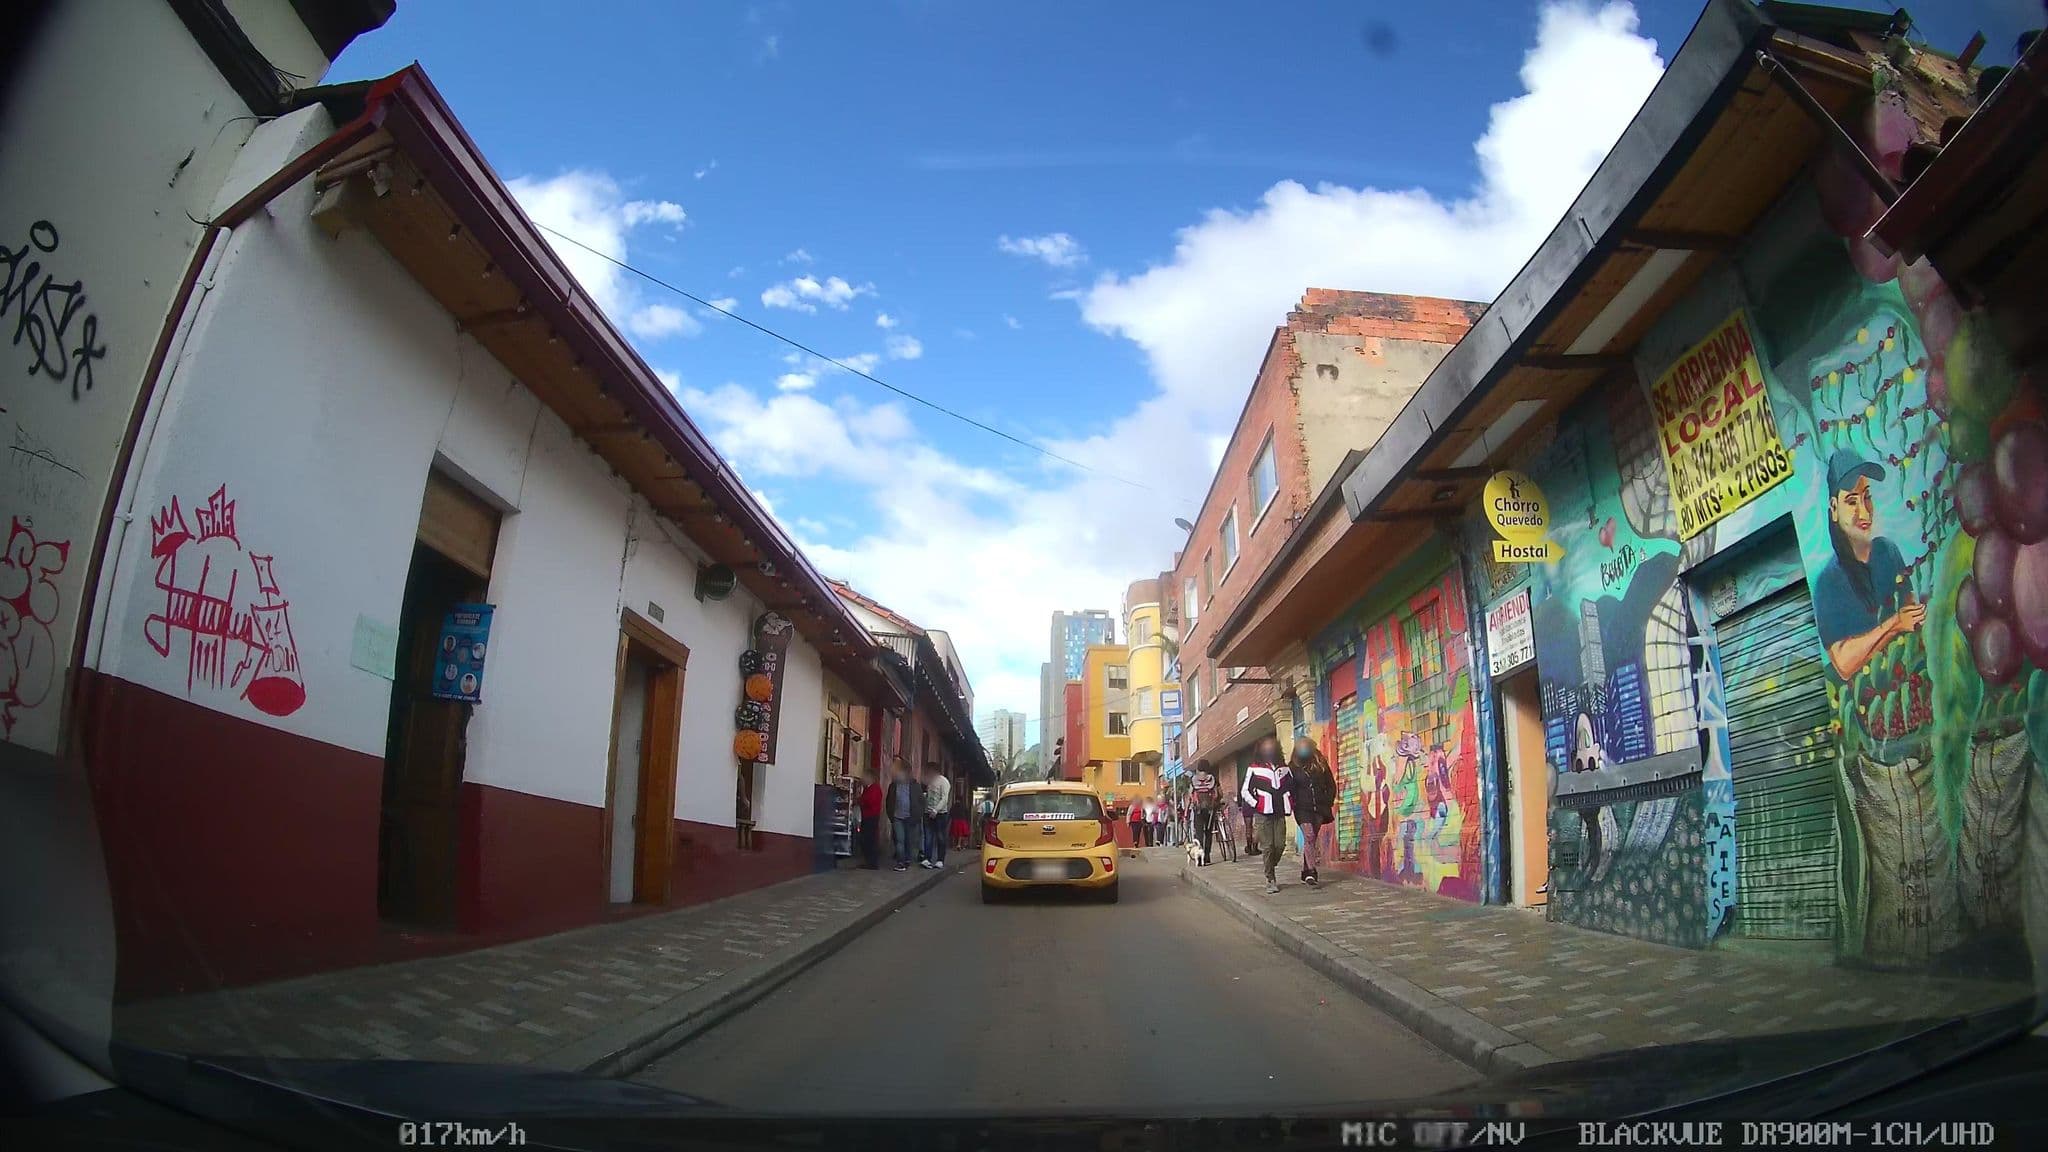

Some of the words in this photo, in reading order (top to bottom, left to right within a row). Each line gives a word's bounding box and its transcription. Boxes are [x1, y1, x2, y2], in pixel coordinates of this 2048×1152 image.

[1652, 381, 1675, 428] SE
[1672, 317, 1754, 413] ARRIENDA
[1664, 368, 1764, 458] LOCAL
[1671, 455, 1694, 502] Cel.
[1691, 438, 1717, 488] 312
[1715, 424, 1741, 473] 305
[1737, 409, 1757, 458] 77
[1756, 395, 1777, 444] 16
[1680, 505, 1694, 533] 80
[1735, 470, 1748, 499] 2
[1747, 443, 1788, 493] PISOS
[1494, 497, 1540, 513] Chorro
[1496, 513, 1544, 527] Quevedo
[1501, 543, 1548, 558] Hostal
